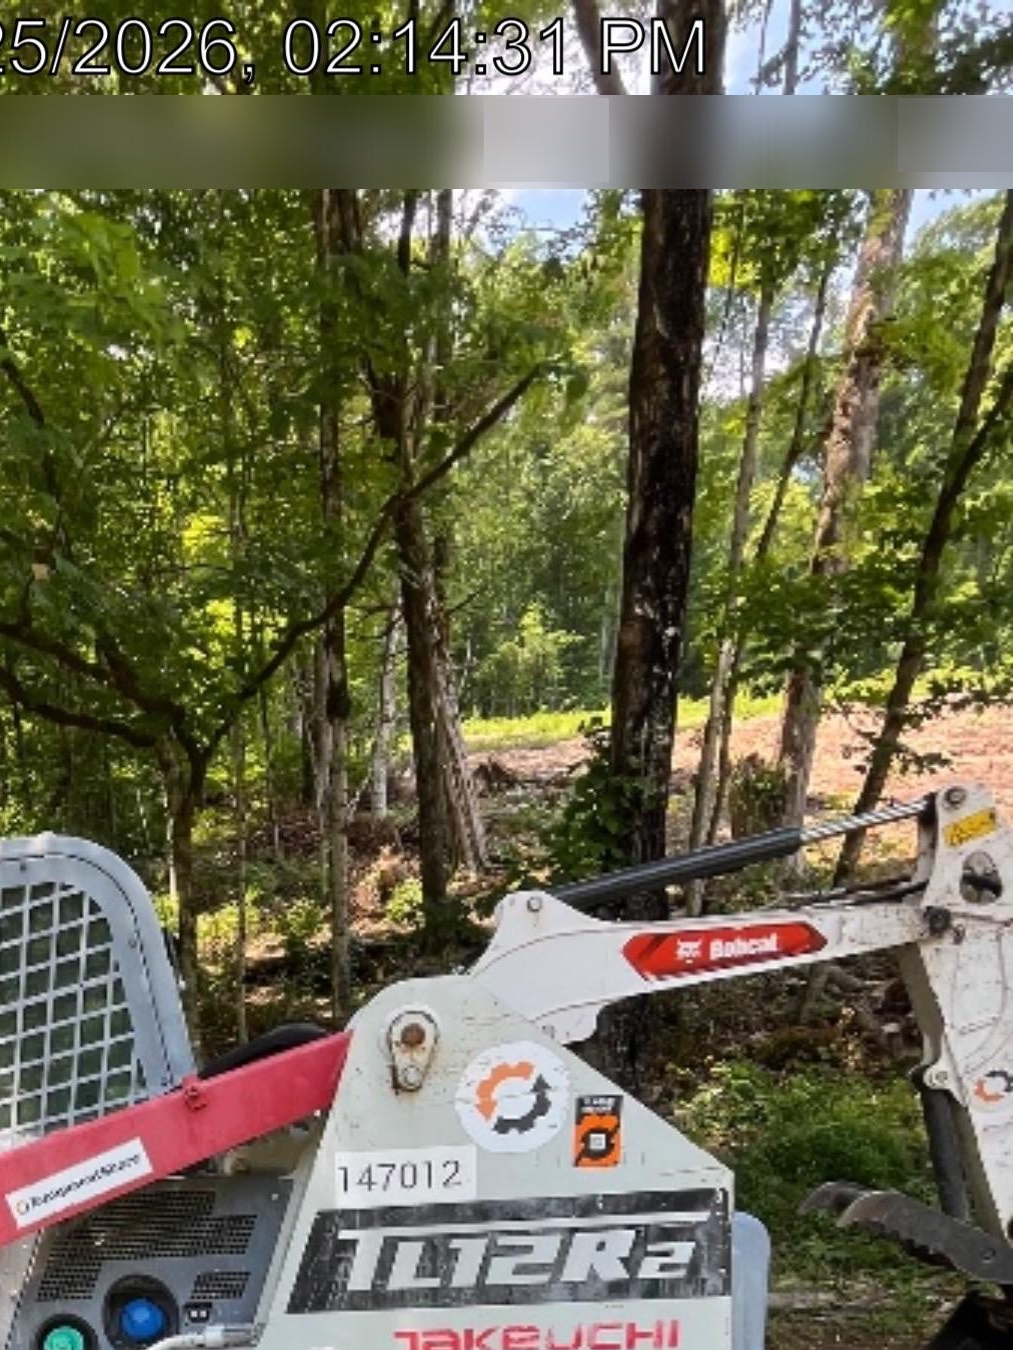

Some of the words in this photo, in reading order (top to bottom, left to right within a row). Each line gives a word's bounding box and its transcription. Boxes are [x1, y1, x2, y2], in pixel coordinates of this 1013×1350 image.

[709, 932, 778, 961] Bobcat
[337, 1160, 462, 1193] 147012
[337, 1229, 696, 1291] TL12R2
